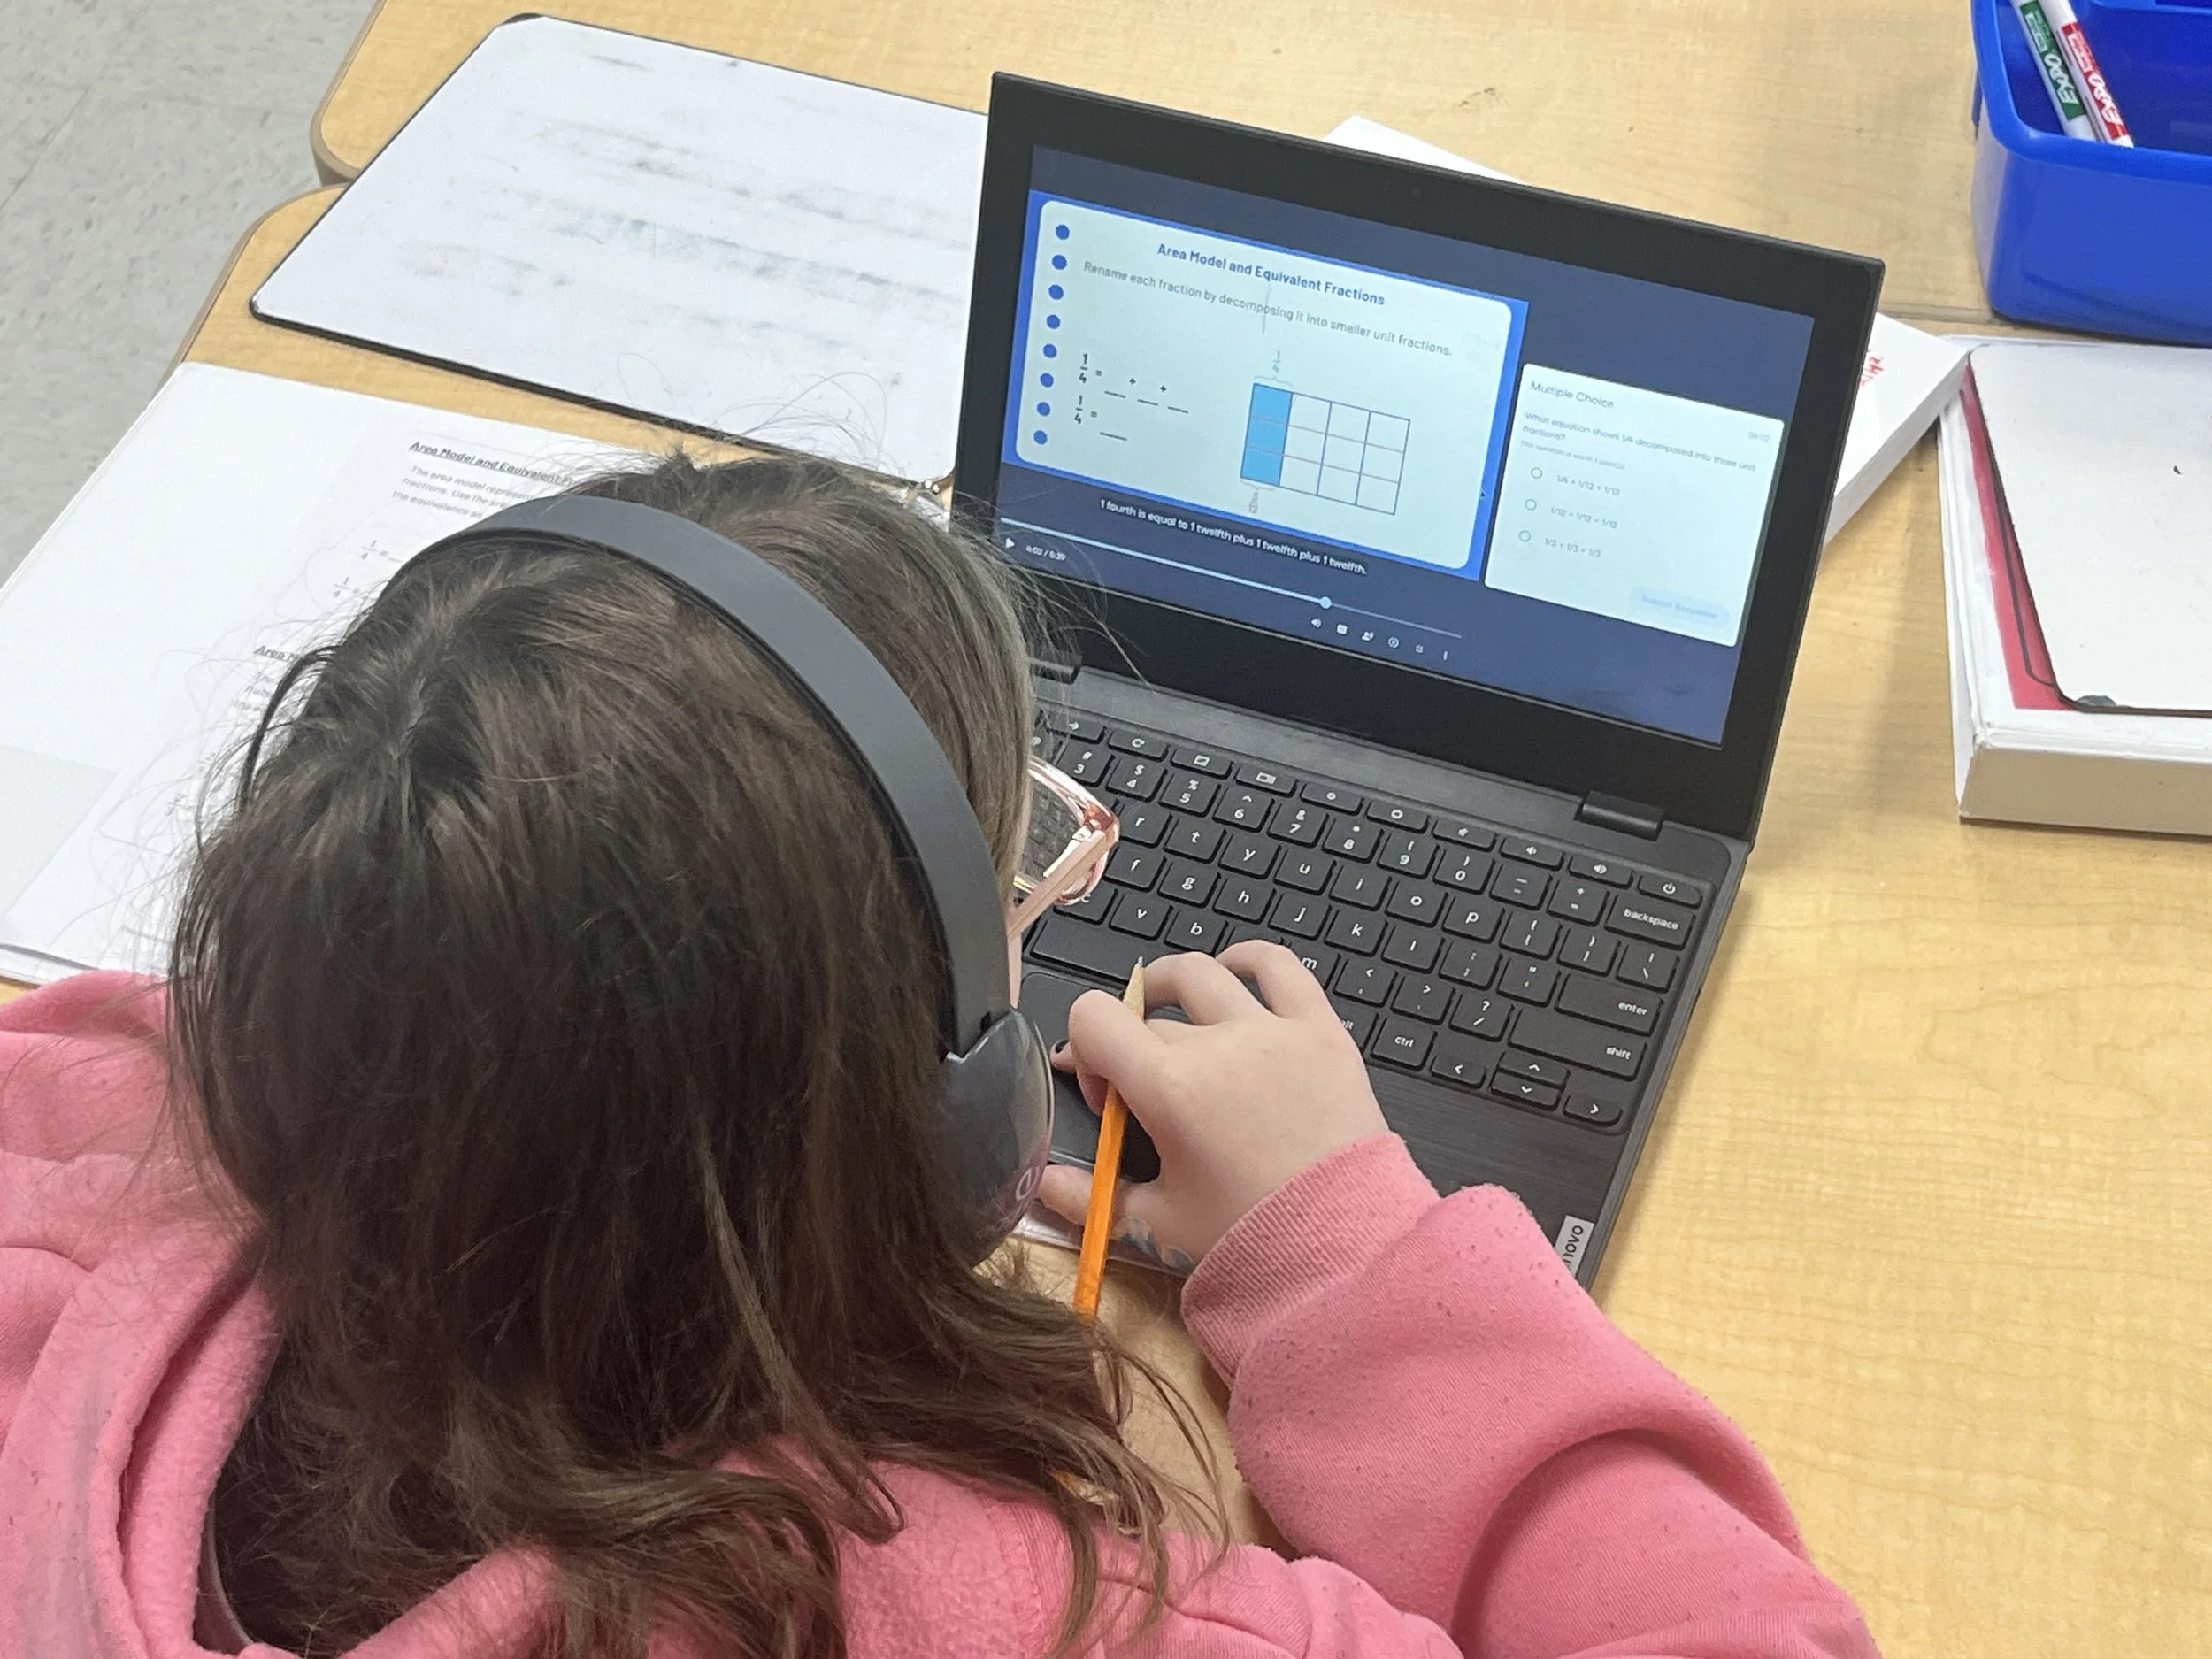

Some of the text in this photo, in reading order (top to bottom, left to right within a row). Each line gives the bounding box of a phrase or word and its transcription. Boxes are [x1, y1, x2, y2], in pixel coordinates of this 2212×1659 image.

[2044, 53, 2080, 105] EXPO
[2088, 73, 2124, 125] EXPO
[1157, 243, 1385, 305] Area Model and Equivalent Fractions
[1083, 260, 1452, 357] Rename each fraction by decomposing it into smaller unit fractions.
[1530, 380, 1614, 408] Multiple Choice
[1522, 425, 1566, 441] fractions?
[1525, 411, 1550, 425] What
[1551, 419, 1590, 433] equation
[1593, 428, 1619, 440] shows
[1635, 438, 1694, 457] decomposed
[1694, 452, 1711, 462] into
[1714, 456, 1737, 467] three
[1739, 462, 1756, 472] unit
[409, 442, 438, 455] Area
[440, 449, 476, 465] Model
[475, 458, 499, 470] and
[498, 462, 561, 483] Equivalent
[1106, 500, 1137, 517] fourth
[1138, 508, 1146, 519] is
[1148, 513, 1177, 526] equal
[1178, 519, 1189, 530] to
[1197, 524, 1232, 541] twelfth
[1233, 534, 1254, 547] plus
[1263, 541, 1298, 557] twelfth
[1299, 551, 1320, 565] plus
[1073, 764, 1085, 774] 3
[1126, 779, 1137, 789] 4
[1179, 793, 1191, 803] 5
[1234, 809, 1245, 818] 6
[1134, 816, 1145, 827] r
[1289, 823, 1301, 833] 7
[1191, 831, 1201, 843] t
[1343, 839, 1355, 849] 8
[1243, 848, 1256, 861] y
[1399, 854, 1410, 865] 9
[1131, 859, 1141, 871] f
[1299, 864, 1310, 874] u
[1181, 877, 1196, 890] g
[1238, 890, 1249, 903] h
[1410, 895, 1423, 906] o
[1137, 908, 1148, 919] v
[1465, 911, 1479, 924] p
[1624, 908, 1679, 930] backspace
[1190, 922, 1202, 935] b
[1351, 923, 1363, 937] k
[1302, 956, 1317, 970] m
[1617, 1001, 1648, 1016] enter
[1394, 1035, 1415, 1048] ctrl
[1605, 1045, 1632, 1060] shift
[1562, 1225, 1584, 1264] novo
